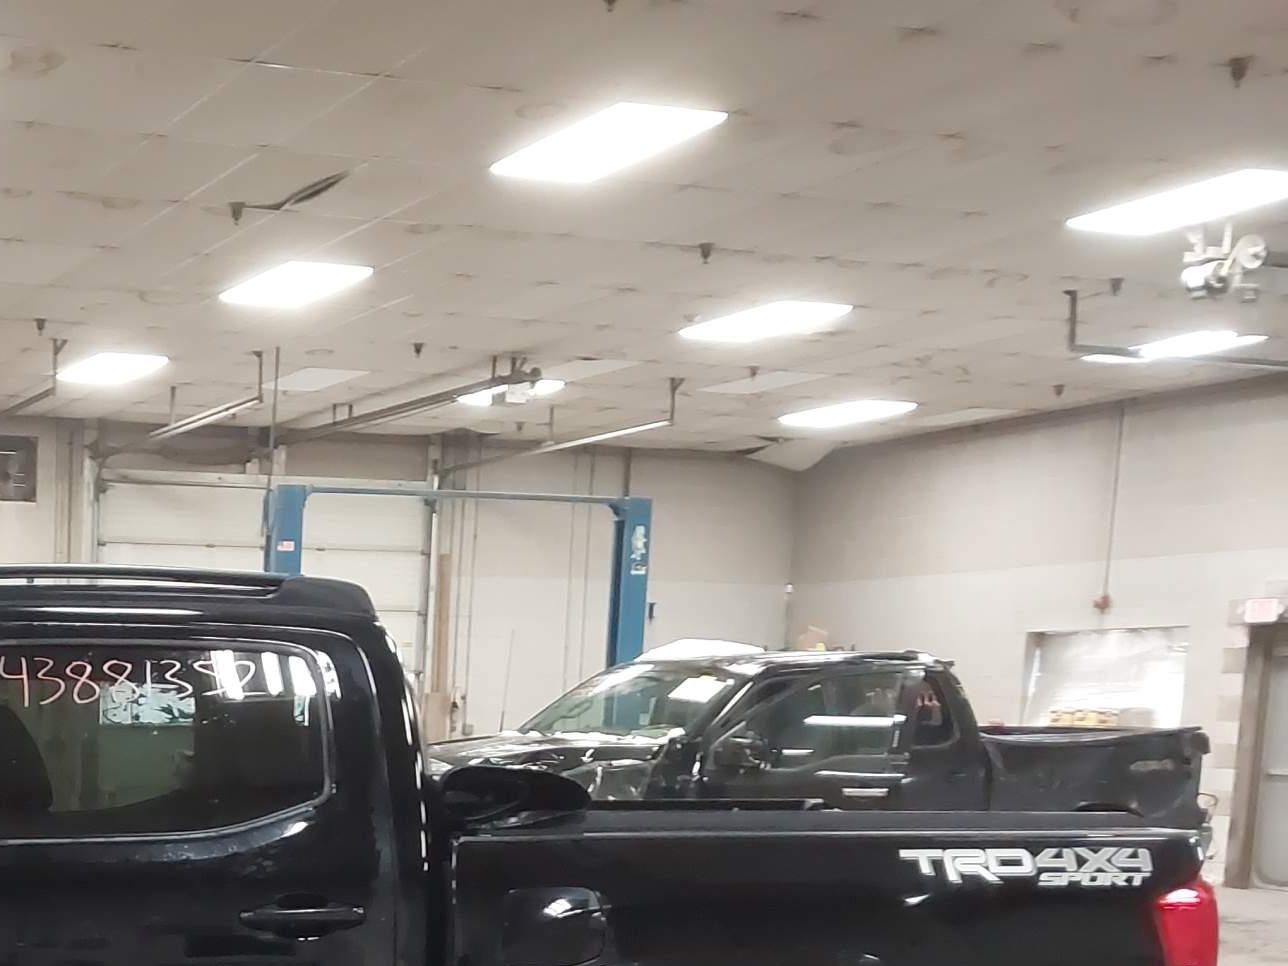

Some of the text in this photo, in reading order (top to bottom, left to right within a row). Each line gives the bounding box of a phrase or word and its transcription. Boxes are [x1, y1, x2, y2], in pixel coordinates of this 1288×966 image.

[0, 655, 268, 708] 43881352
[899, 849, 1038, 883] TRD
[1037, 872, 1152, 886] SPORT
